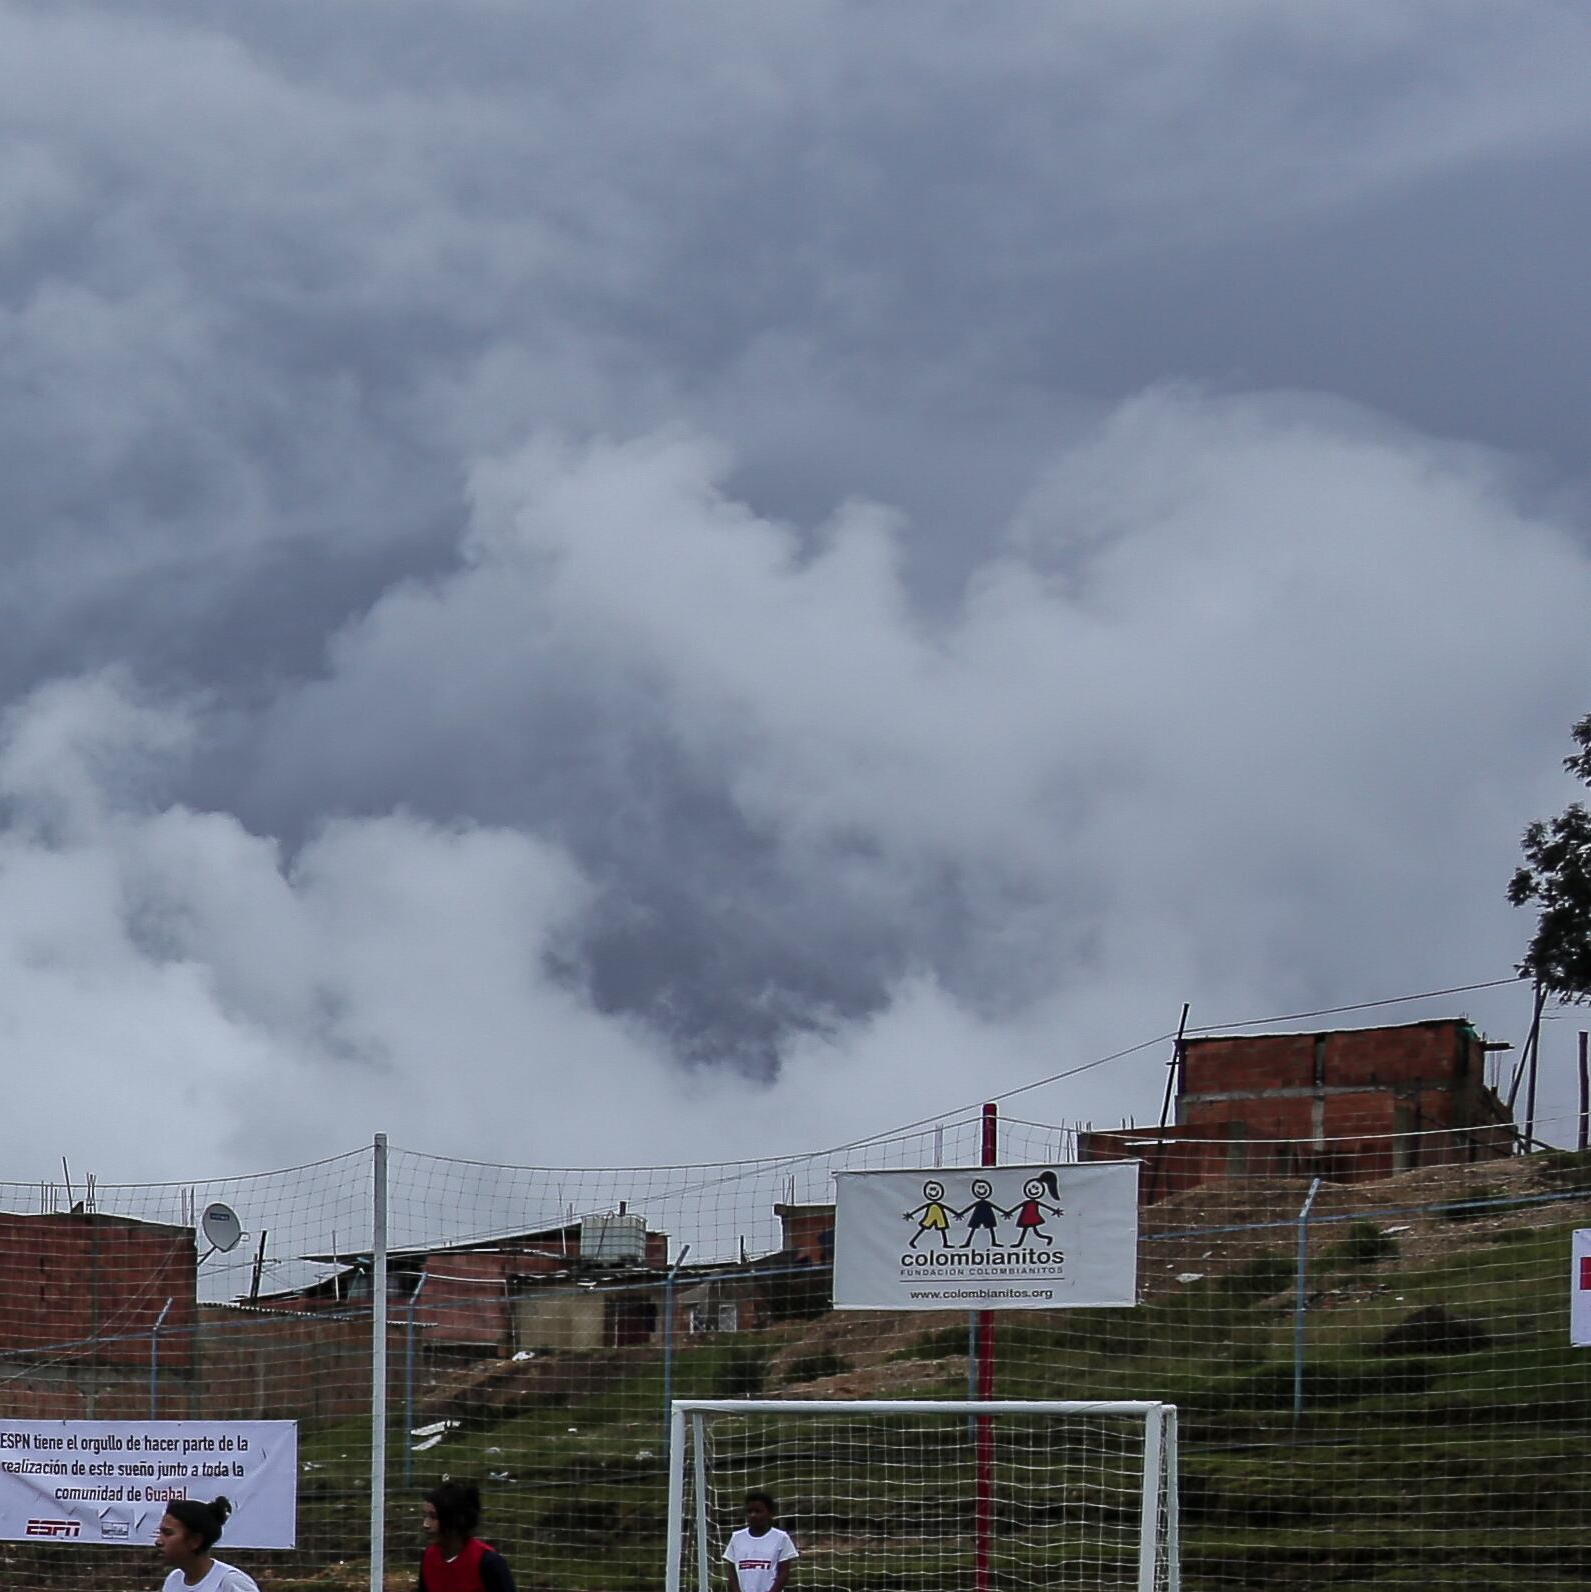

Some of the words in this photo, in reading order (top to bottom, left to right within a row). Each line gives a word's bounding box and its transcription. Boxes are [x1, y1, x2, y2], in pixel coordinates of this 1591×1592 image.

[901, 1248, 1064, 1267] colombianitos
[969, 1267, 1064, 1276] COLOMBIANITOS
[910, 1288, 1053, 1300] www.colombianitos.org
[0, 1433, 31, 1449] ESPN
[34, 1434, 63, 1450] tiene
[67, 1435, 78, 1450] el
[81, 1435, 123, 1455] orgullo
[127, 1435, 141, 1451] de
[144, 1435, 179, 1451] hacer
[183, 1436, 214, 1455] parte
[219, 1435, 233, 1451] de
[237, 1435, 248, 1451] la
[1, 1459, 68, 1475] realización
[71, 1460, 86, 1475] de
[89, 1461, 114, 1476] este
[118, 1461, 154, 1476] sueño
[157, 1461, 188, 1480] junto
[191, 1465, 199, 1476] a
[202, 1461, 229, 1477] toda
[232, 1461, 244, 1477] la
[55, 1485, 123, 1501] comunidad
[127, 1486, 141, 1501] de
[26, 1519, 80, 1537] ESPN
[738, 1559, 771, 1570] ESPN
